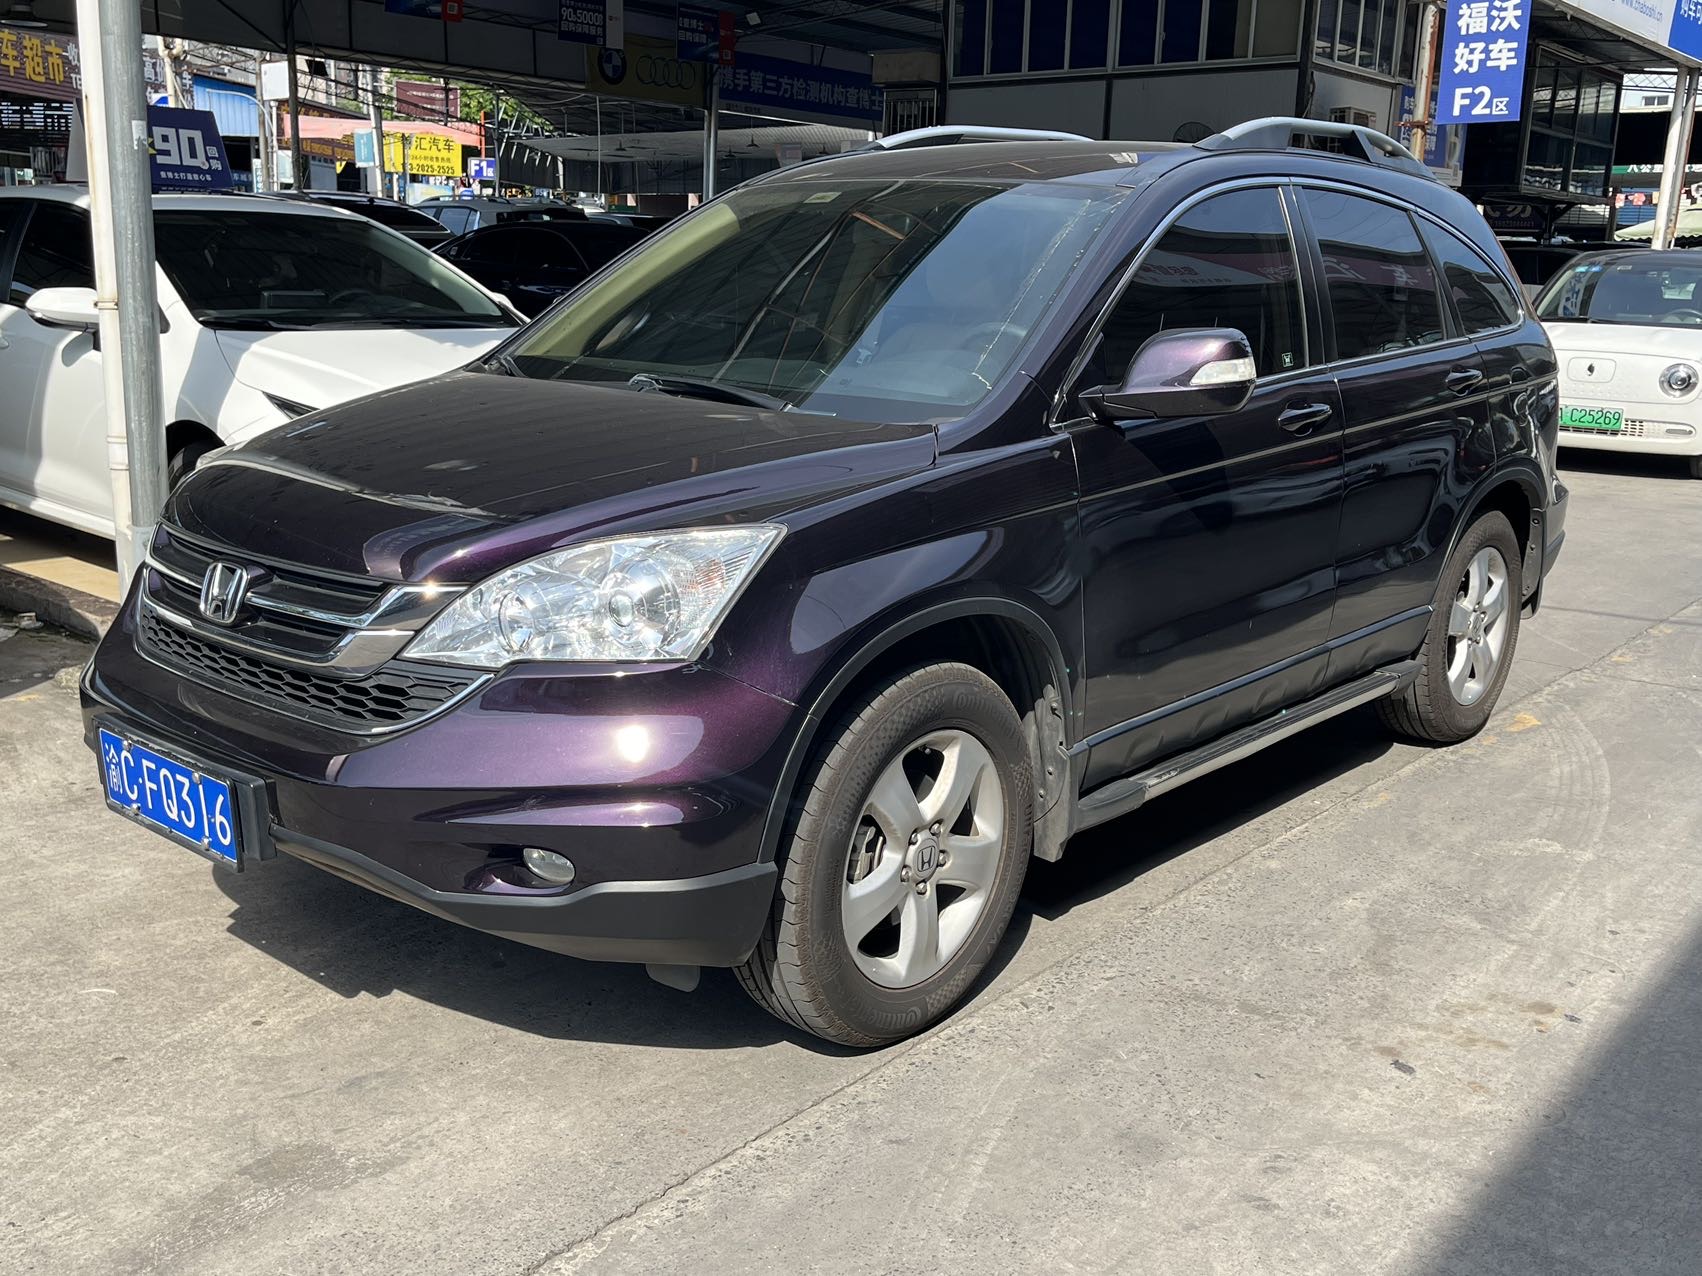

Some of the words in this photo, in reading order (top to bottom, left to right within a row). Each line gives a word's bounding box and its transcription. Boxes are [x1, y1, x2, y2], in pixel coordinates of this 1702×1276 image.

[1457, 0, 1522, 35] 福沃
[0, 29, 65, 85] 车超市
[1453, 39, 1518, 74] 好车
[1452, 85, 1510, 117] F2区
[152, 126, 207, 167] 90
[415, 136, 455, 153] 汇汽车
[470, 160, 495, 177] F1区
